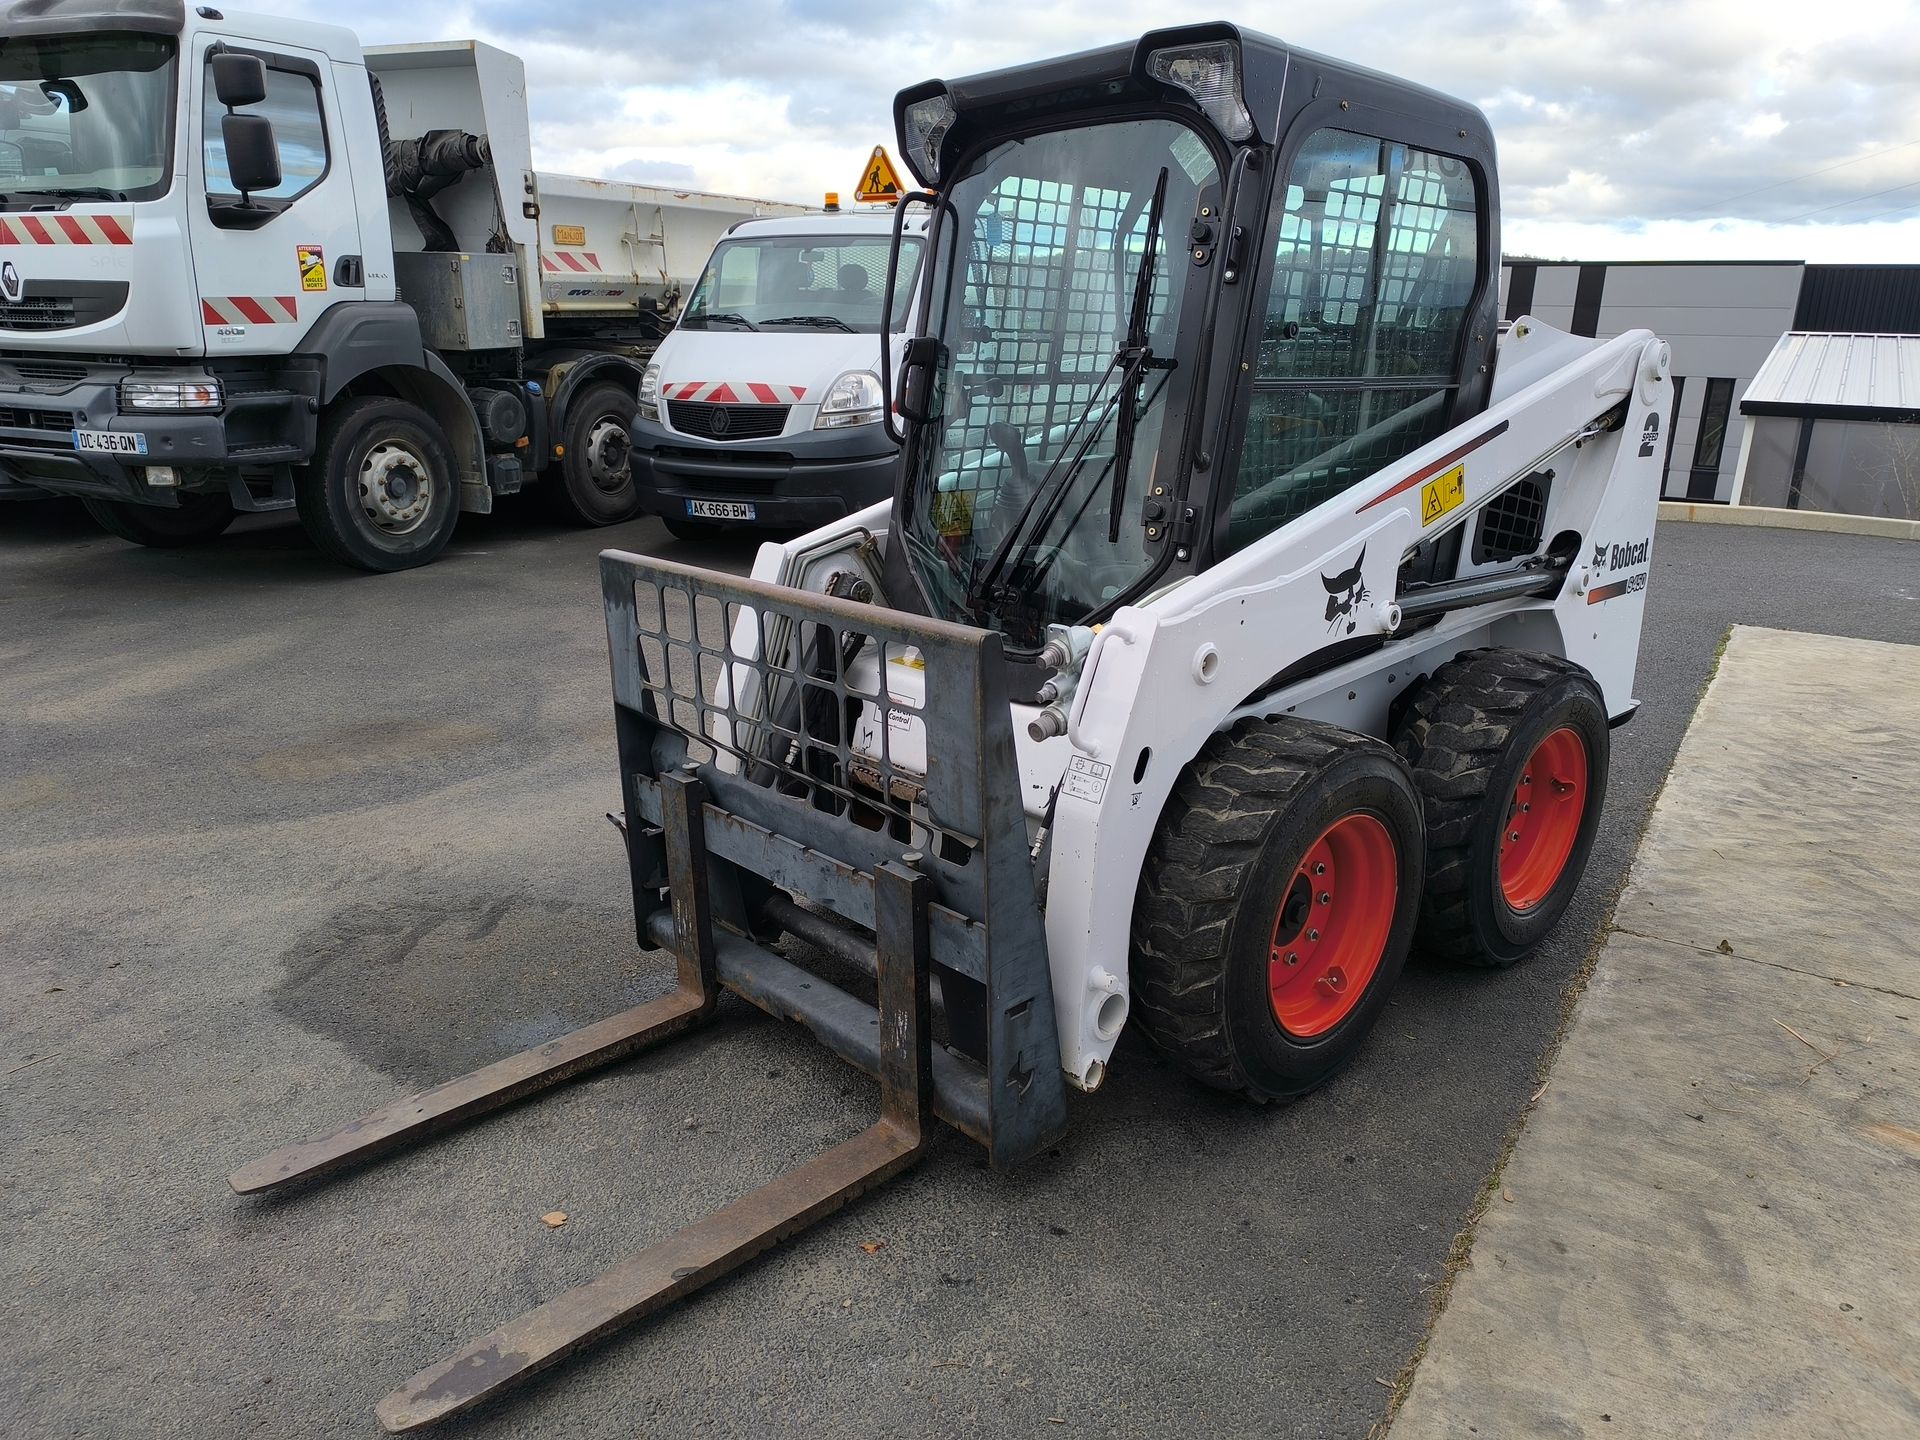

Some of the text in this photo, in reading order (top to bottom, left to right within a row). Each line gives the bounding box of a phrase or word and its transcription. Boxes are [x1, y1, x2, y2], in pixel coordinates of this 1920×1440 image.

[79, 433, 137, 451] DC-436-QN
[1641, 432, 1659, 442] SPEED
[693, 502, 747, 518] AK-666-BW
[1609, 537, 1649, 571] Bobcat
[1626, 572, 1647, 594] S450
[888, 712, 910, 724] Control
